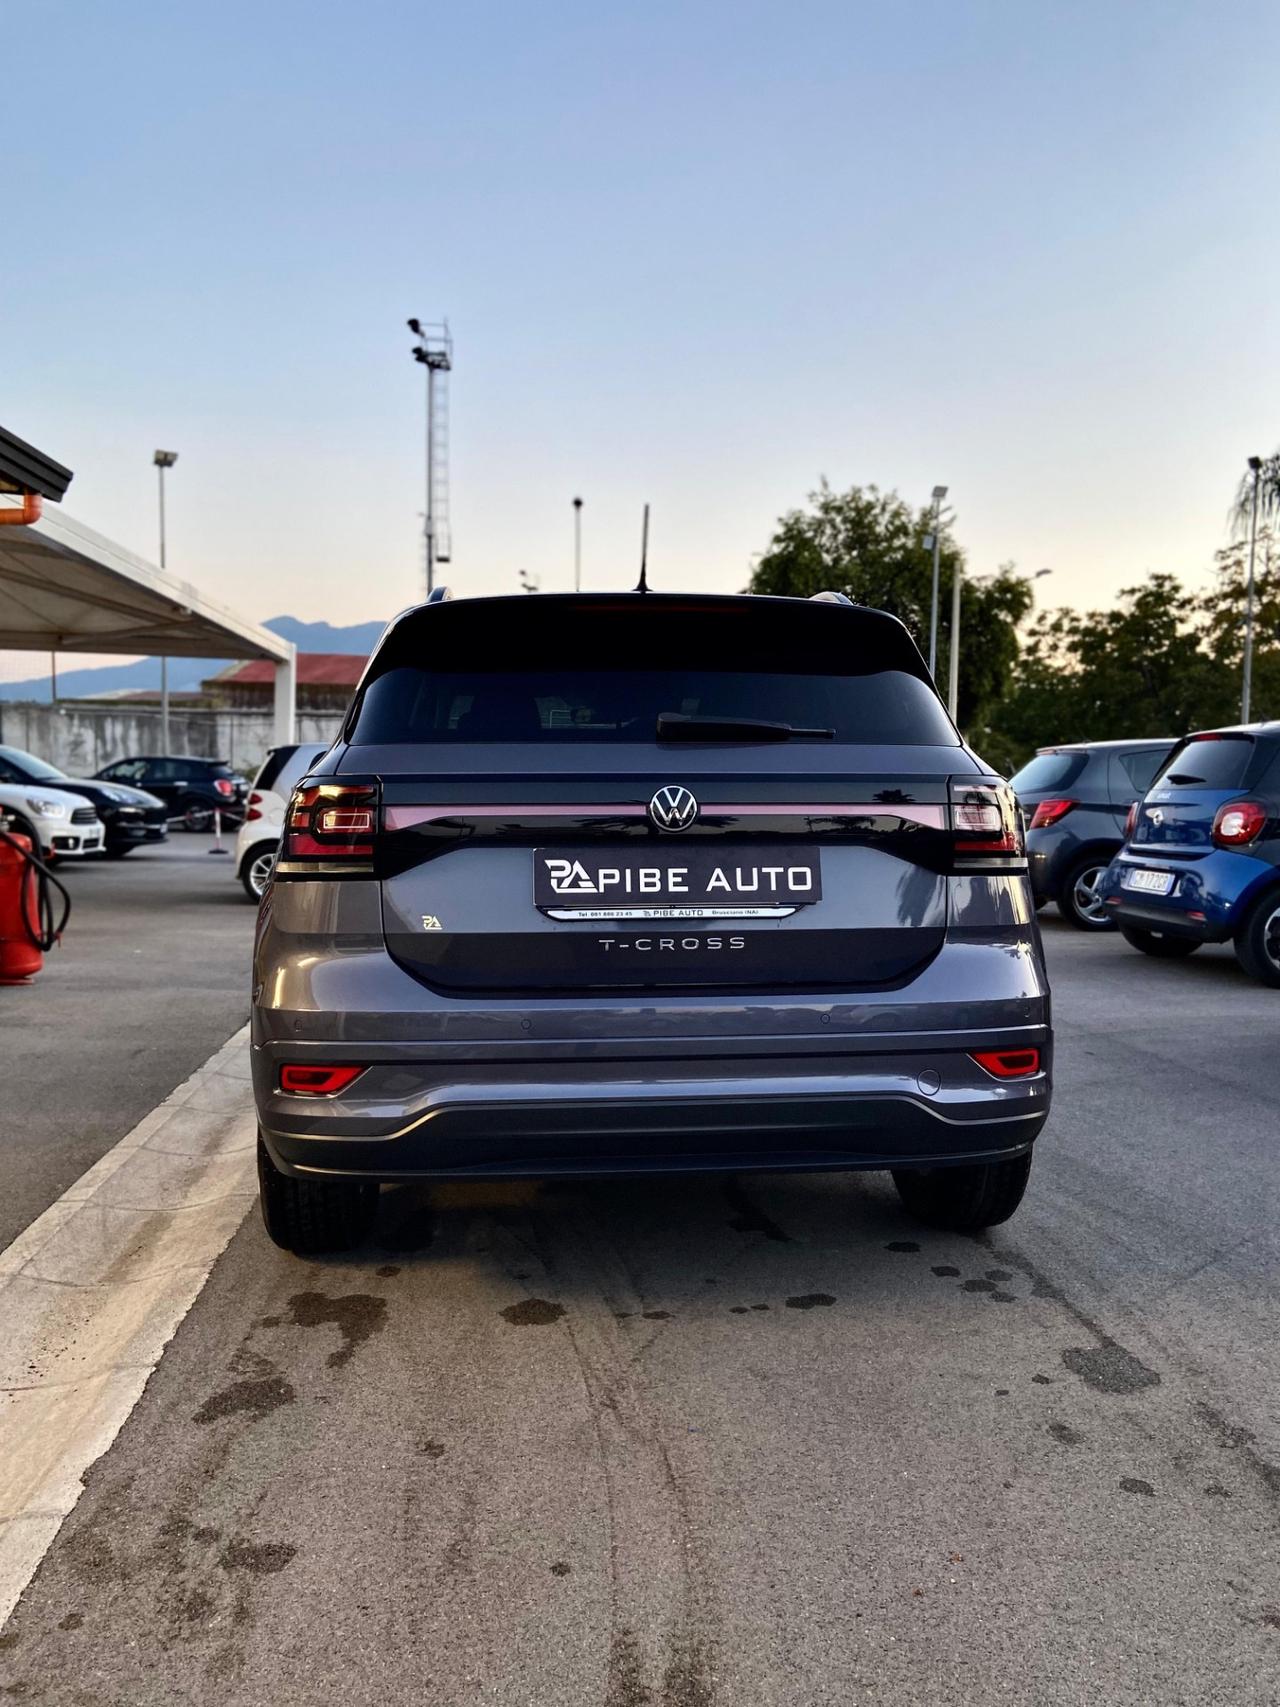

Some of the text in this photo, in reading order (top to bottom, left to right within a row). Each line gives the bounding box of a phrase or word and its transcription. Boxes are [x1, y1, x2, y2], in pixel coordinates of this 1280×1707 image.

[650, 786, 697, 831] VW
[598, 867, 689, 893] PIBE
[705, 866, 812, 892] AUTO
[598, 937, 746, 951] T-CROSS
